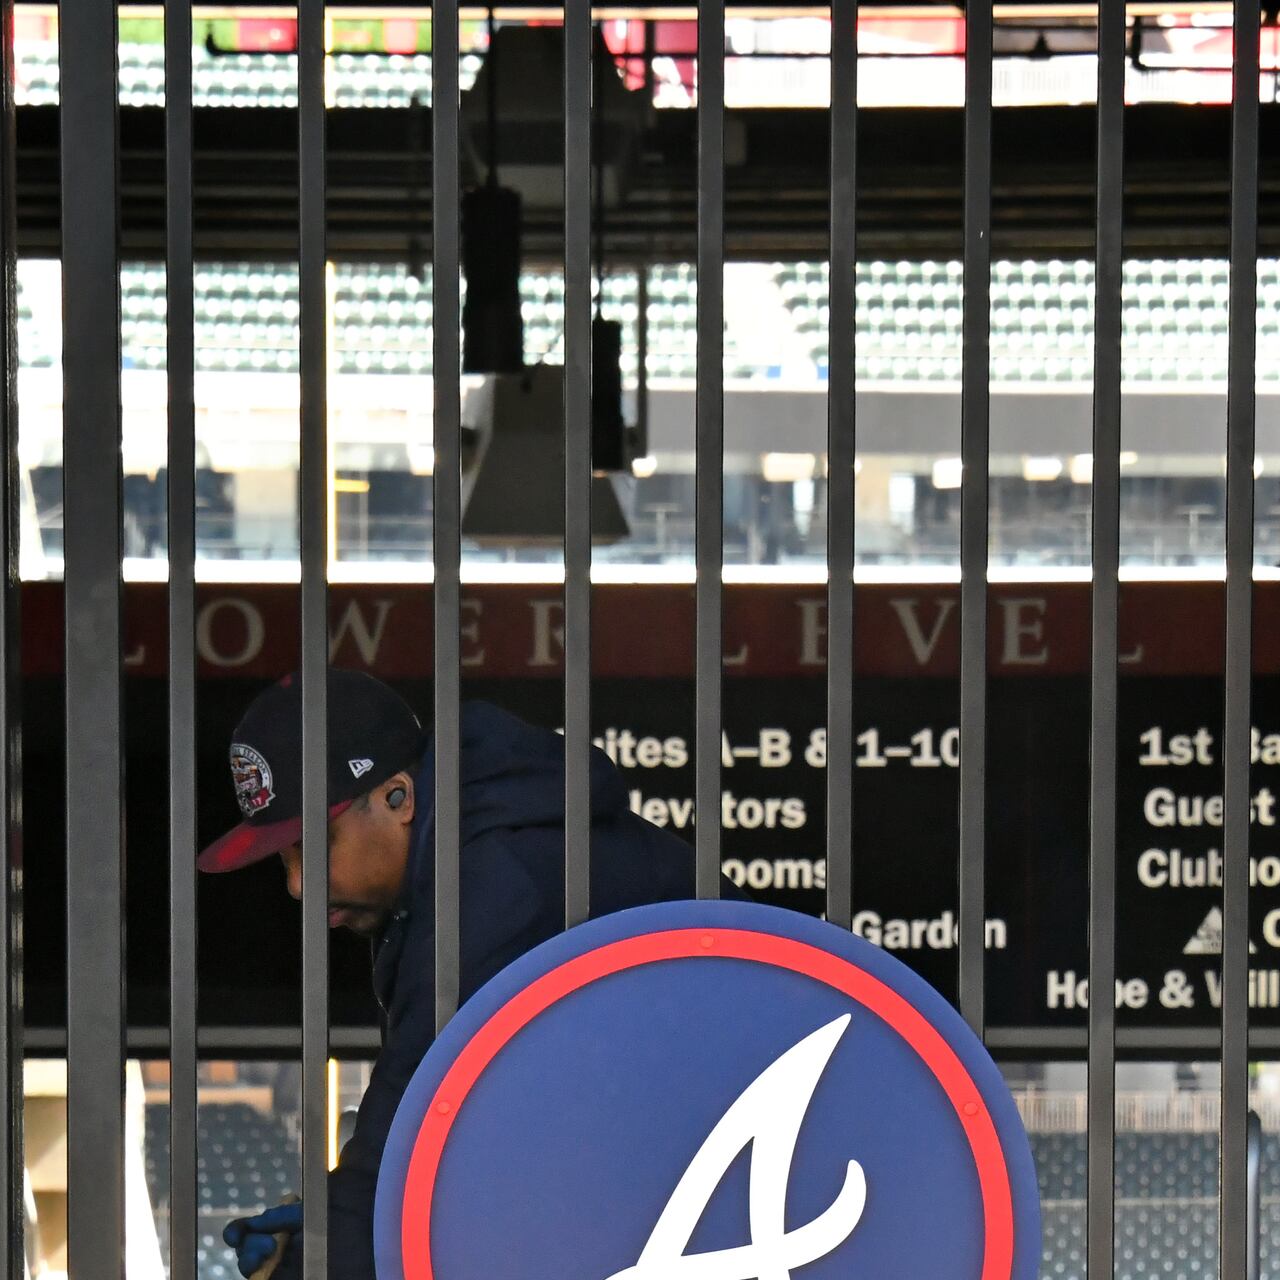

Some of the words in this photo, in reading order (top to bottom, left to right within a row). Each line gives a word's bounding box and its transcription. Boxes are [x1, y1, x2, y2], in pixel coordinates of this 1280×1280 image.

[1138, 726, 1214, 766] 1st
[852, 911, 1007, 949] Gardn
[1159, 970, 1194, 1009] &
